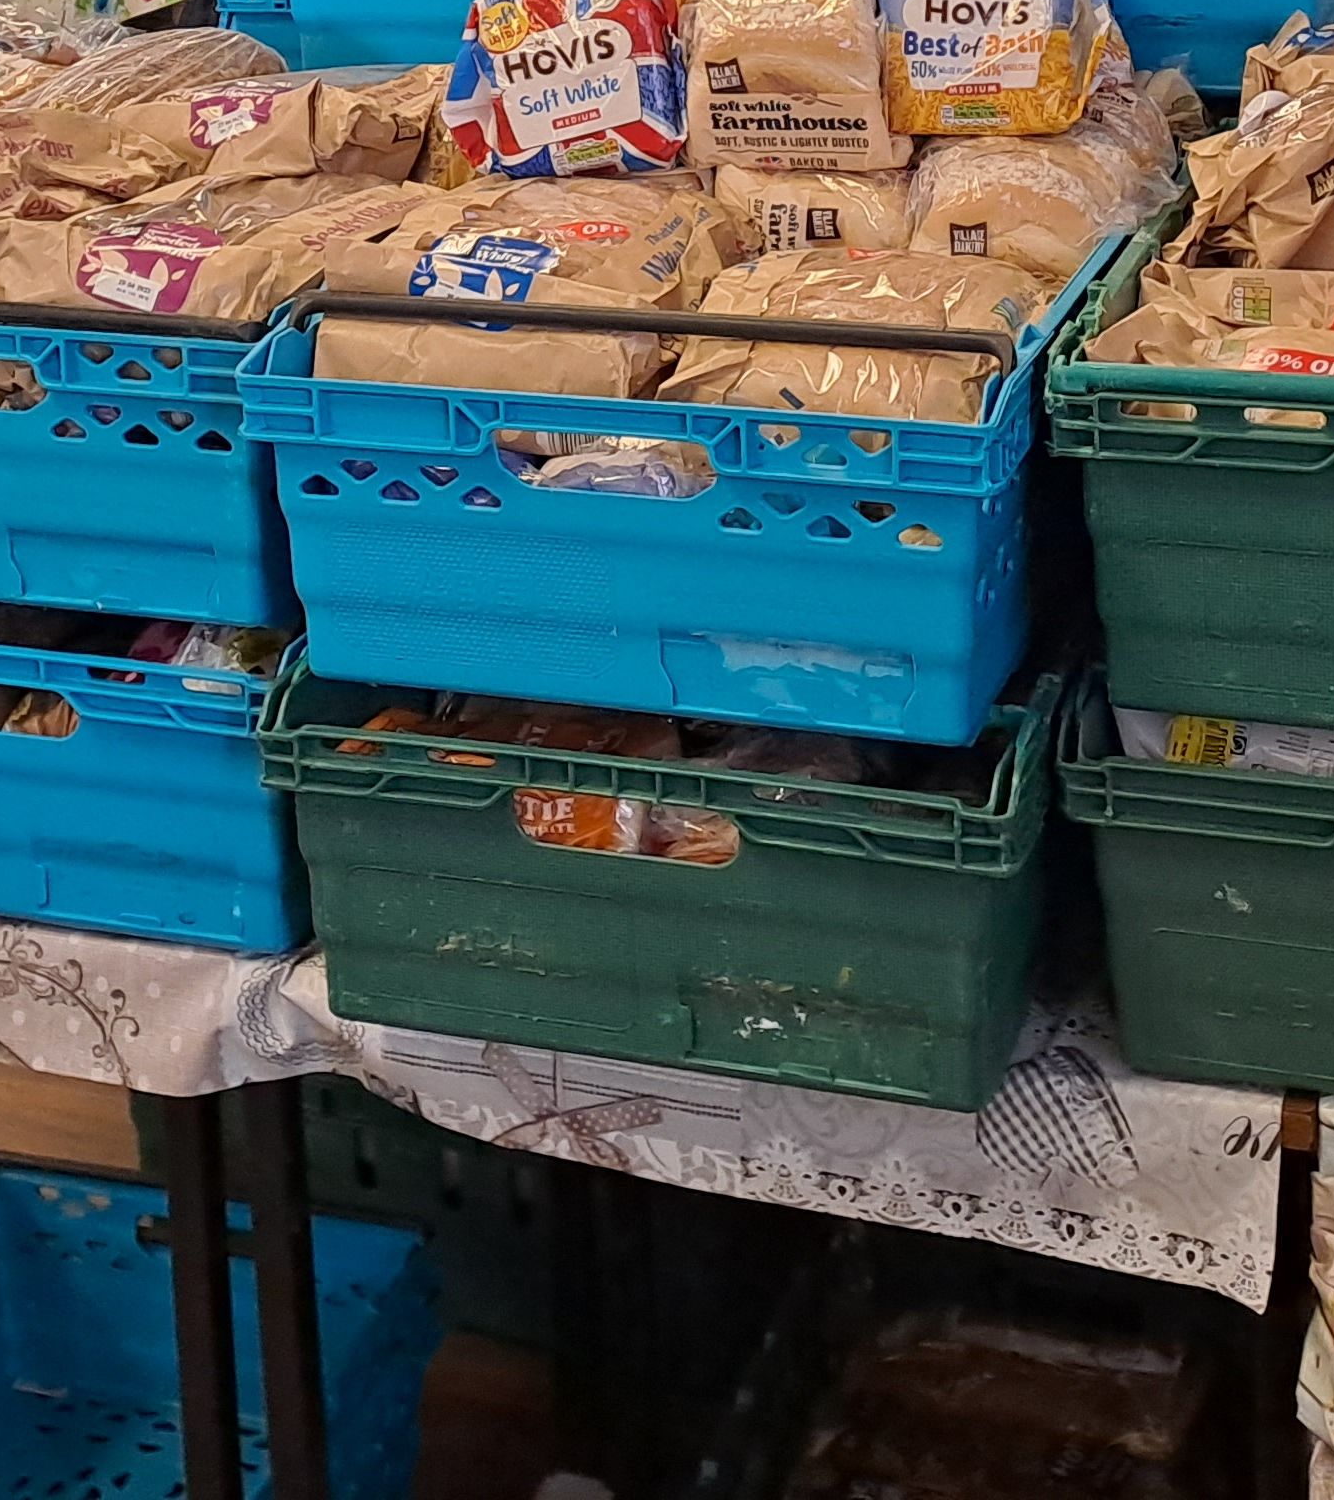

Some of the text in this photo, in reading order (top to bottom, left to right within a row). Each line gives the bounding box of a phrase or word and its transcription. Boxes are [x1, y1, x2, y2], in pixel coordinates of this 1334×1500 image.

[482, 5, 517, 31] Soft
[904, 30, 960, 58] Best
[961, 36, 983, 59] of
[503, 29, 615, 84] HOVIS
[911, 61, 937, 78] 50%
[520, 74, 620, 115] Soft White
[948, 84, 998, 94] MEDIUM
[709, 100, 792, 112] soft white
[554, 111, 599, 128] MEDIUM
[711, 113, 869, 131] farmhouse
[744, 136, 777, 147] RUSTIC
[790, 137, 828, 147] LIGHTLY
[832, 137, 870, 148] DUSTED
[789, 157, 838, 168] BAKED IN
[581, 221, 627, 237] OFF
[953, 228, 985, 242] VILLAGE
[954, 241, 985, 255] BAKERY
